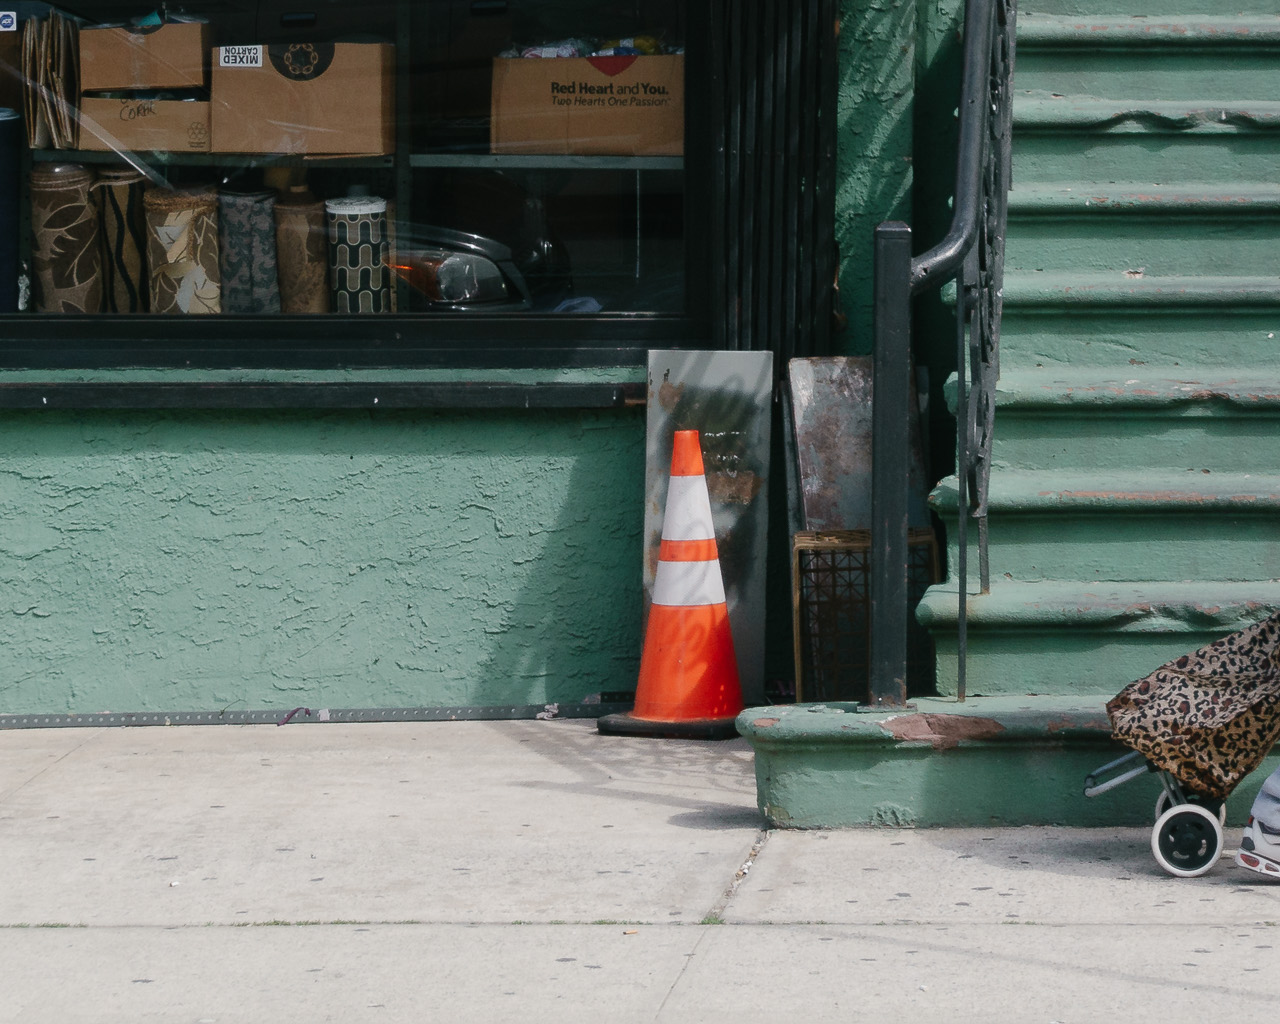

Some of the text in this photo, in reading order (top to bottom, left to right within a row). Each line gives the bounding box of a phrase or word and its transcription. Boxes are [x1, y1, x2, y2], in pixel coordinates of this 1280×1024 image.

[224, 46, 258, 55] CARTON
[223, 55, 259, 65] MIXED
[551, 82, 669, 95] Red Heart and You.
[551, 96, 571, 107] Two
[574, 96, 606, 107] Hearts
[607, 96, 628, 107] One
